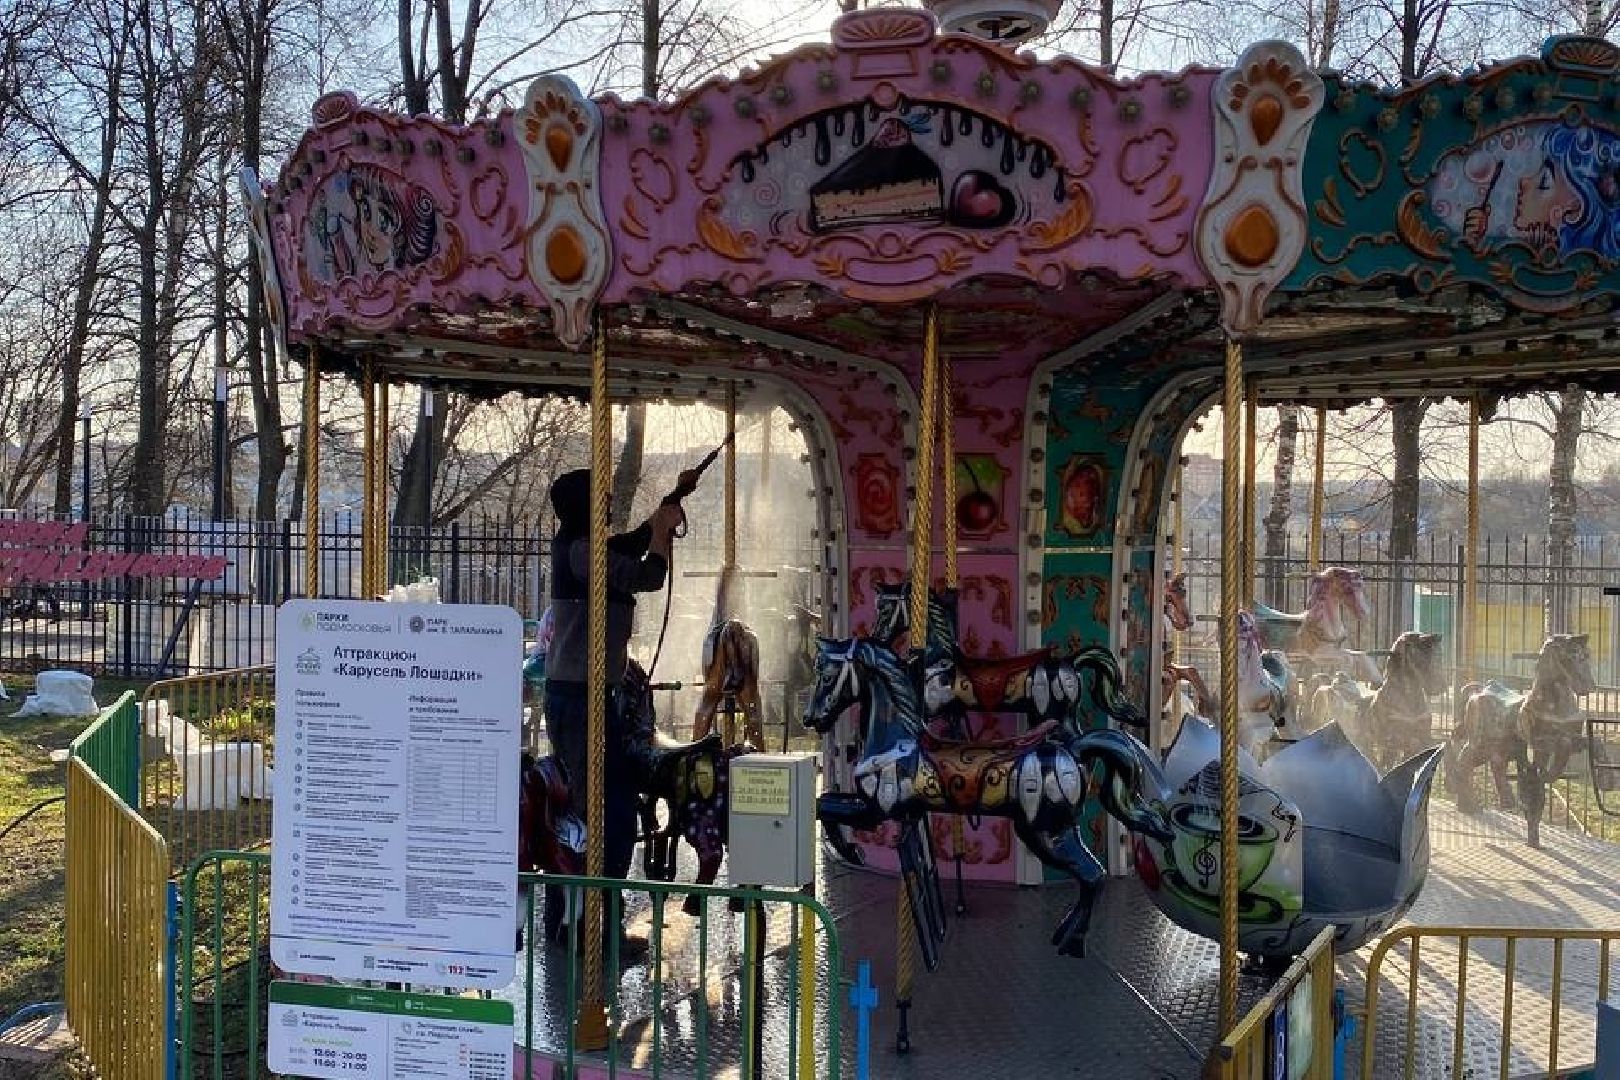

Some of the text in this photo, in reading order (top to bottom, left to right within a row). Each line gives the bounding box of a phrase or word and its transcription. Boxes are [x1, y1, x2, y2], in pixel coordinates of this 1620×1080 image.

[316, 611, 350, 622] ПАРКИ
[333, 645, 417, 662] Аттракцион
[333, 662, 483, 682] «Карусель Лошадки»
